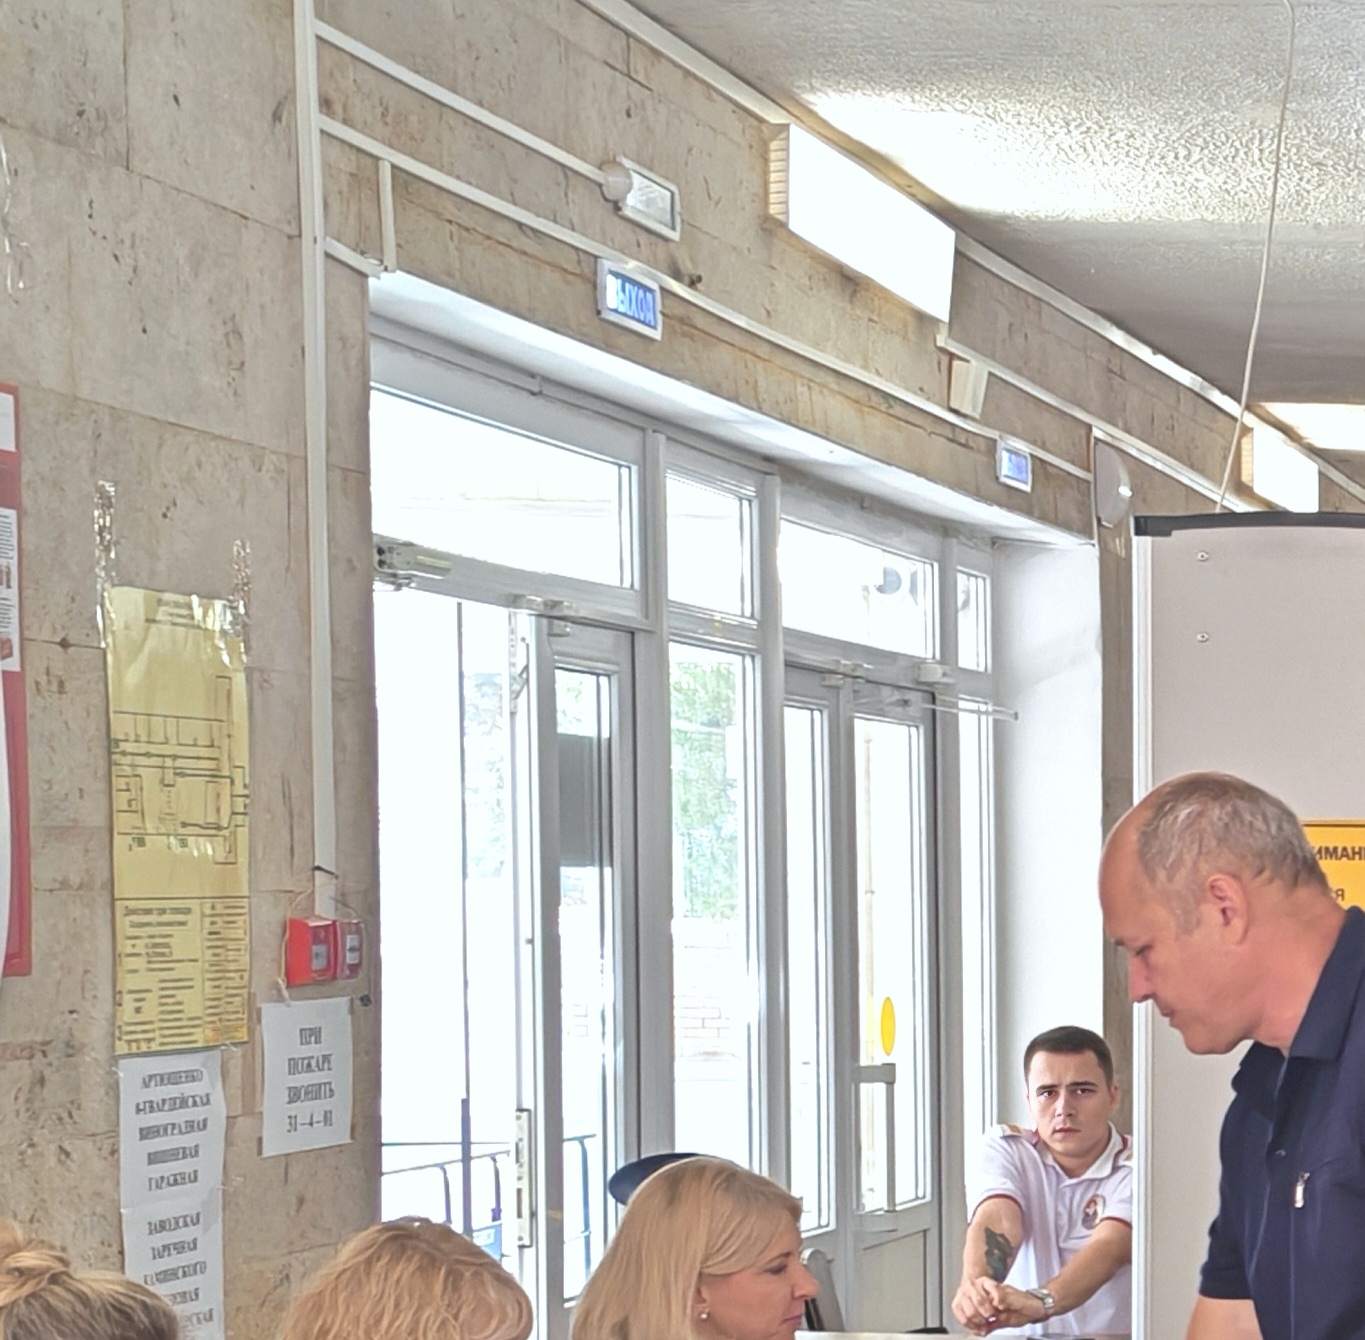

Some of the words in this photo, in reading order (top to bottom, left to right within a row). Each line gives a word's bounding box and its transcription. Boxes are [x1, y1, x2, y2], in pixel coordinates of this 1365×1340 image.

[606, 273, 656, 327] ЫХОД
[299, 1026, 322, 1046] ПРИ
[287, 1053, 333, 1076] ПОЖАРЕ
[286, 1081, 335, 1105] ЗВОНИТЬ
[148, 1169, 199, 1192] ГАРАЖНАЯ
[147, 1211, 201, 1236] ЗАВОДСКАЯ
